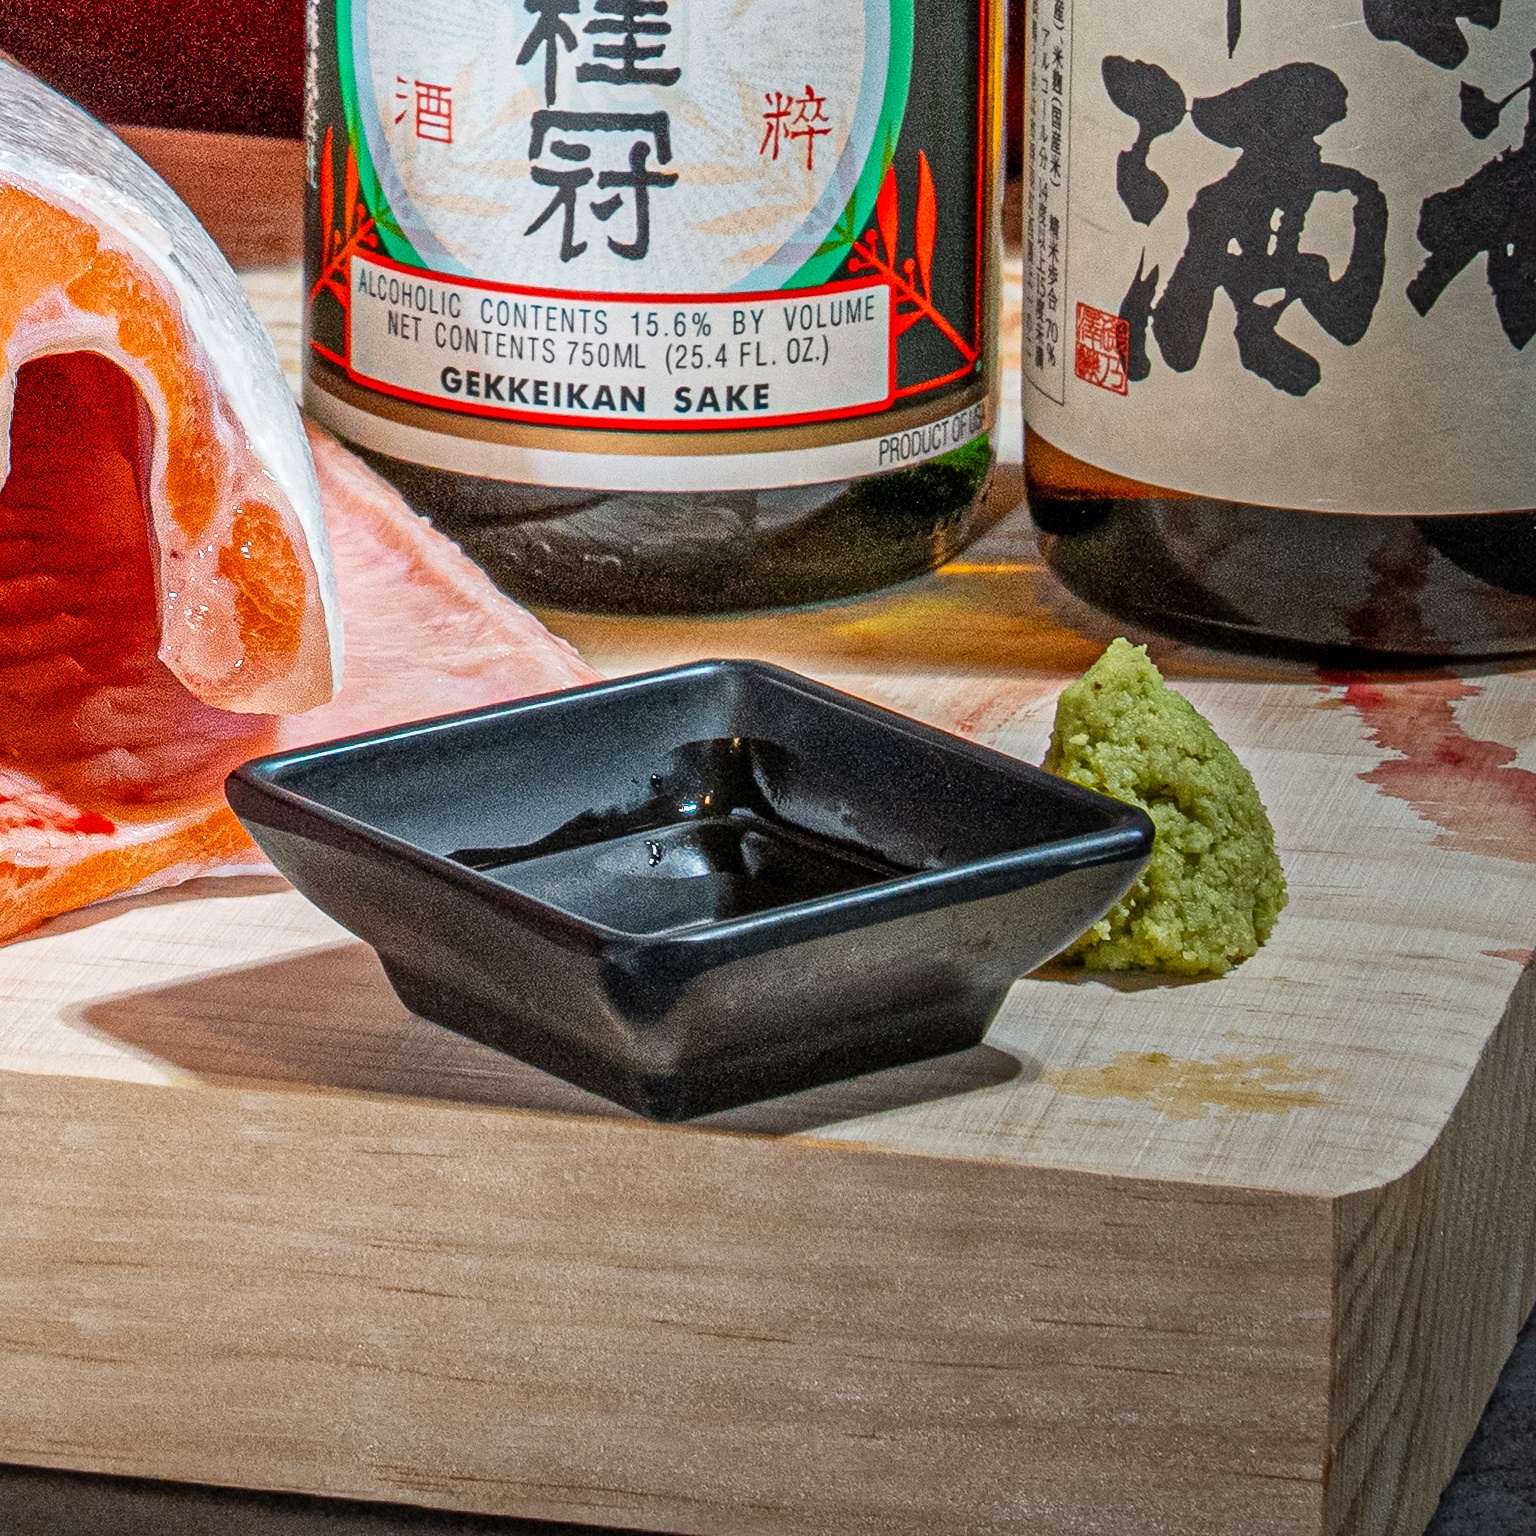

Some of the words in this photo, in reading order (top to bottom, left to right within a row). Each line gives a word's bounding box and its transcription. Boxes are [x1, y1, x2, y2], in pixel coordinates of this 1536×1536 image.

[1101, 54, 1389, 396] 酒
[357, 268, 462, 319] ALCOHOLIC
[480, 298, 608, 336] CONTENTS
[630, 311, 712, 337] 15.6%
[732, 309, 765, 335] BY
[784, 295, 876, 332] VOLUME
[387, 310, 422, 342] NET
[434, 322, 556, 364] CONTENTS
[567, 341, 647, 369] 750ML
[665, 342, 728, 375] (25.4
[739, 341, 777, 367] FL.
[786, 335, 829, 366] OZ.)
[440, 366, 646, 414] GEKKEIKAN
[673, 383, 770, 414] SAKE
[878, 420, 949, 466] PRODUCT
[951, 412, 967, 443] OF
